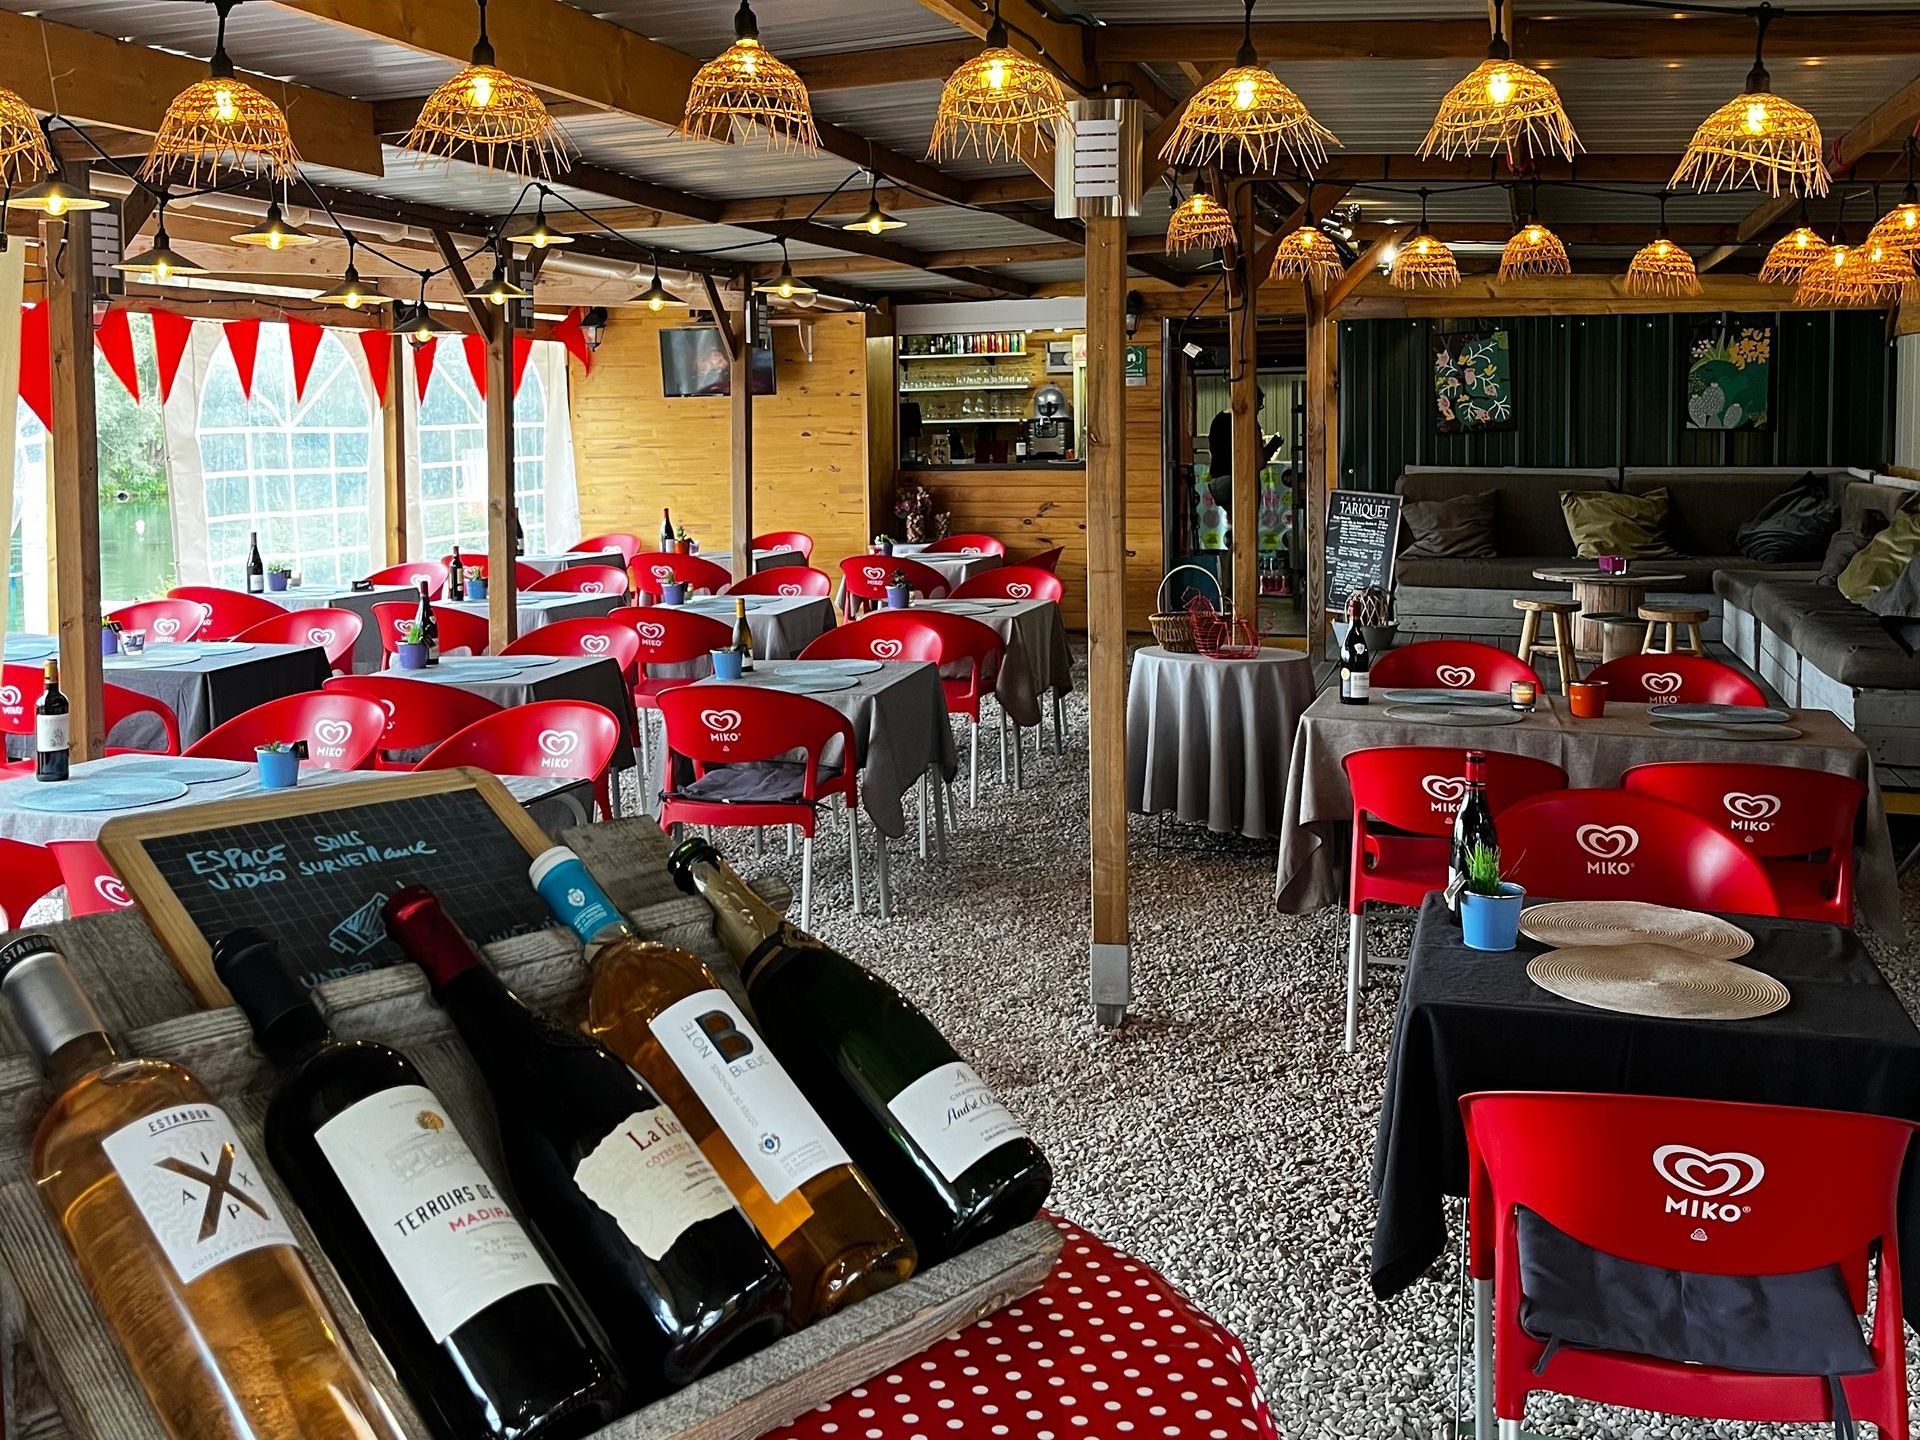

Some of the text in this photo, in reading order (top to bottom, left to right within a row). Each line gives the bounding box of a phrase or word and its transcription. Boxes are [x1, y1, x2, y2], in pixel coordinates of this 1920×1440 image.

[1340, 501, 1391, 520] TARIQUET
[642, 639, 662, 647] MIKO
[1649, 695, 1678, 704] MIKO
[710, 733, 739, 742] MIKO
[317, 747, 343, 757] MIKO
[541, 758, 569, 769] MIKO
[1731, 819, 1770, 831] MIKO
[186, 844, 286, 875] ESPACE
[1587, 861, 1630, 875] MIKO
[680, 1020, 712, 1059] NOTE
[148, 1109, 212, 1133] ESTANDON
[394, 1185, 476, 1237] TERROIRS
[1665, 1194, 1742, 1222] MIKO
[449, 1206, 514, 1233] MADIRA
